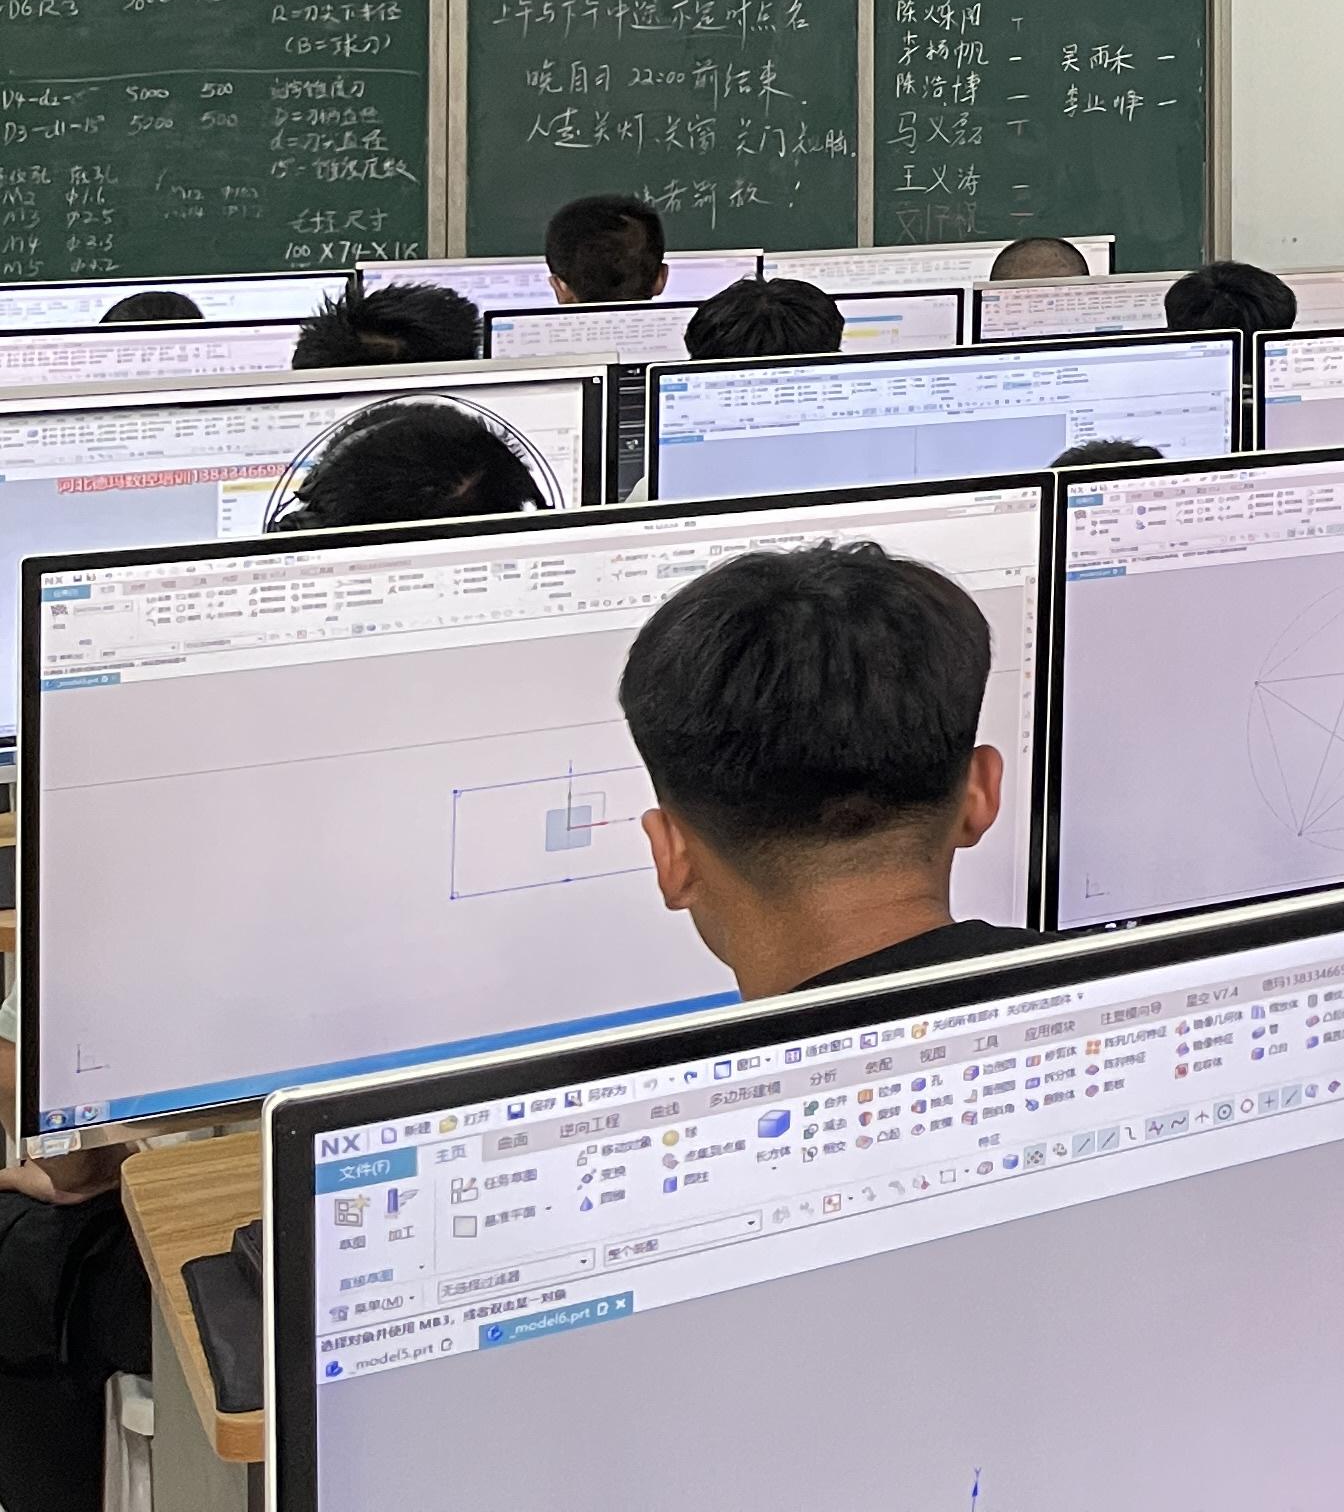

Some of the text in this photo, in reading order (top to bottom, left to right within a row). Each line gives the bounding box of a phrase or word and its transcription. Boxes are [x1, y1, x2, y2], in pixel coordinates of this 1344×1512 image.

[973, 1034, 999, 1053] 工具
[919, 1045, 947, 1064] 视图
[809, 1067, 838, 1087] 分析
[530, 1096, 558, 1114] 保存
[463, 1109, 490, 1127] 打开
[404, 1120, 432, 1138] 新建
[321, 1133, 361, 1158] NX
[435, 1143, 467, 1165] 主页
[338, 1158, 392, 1183] 文件(F)
[387, 1224, 416, 1243] 加工
